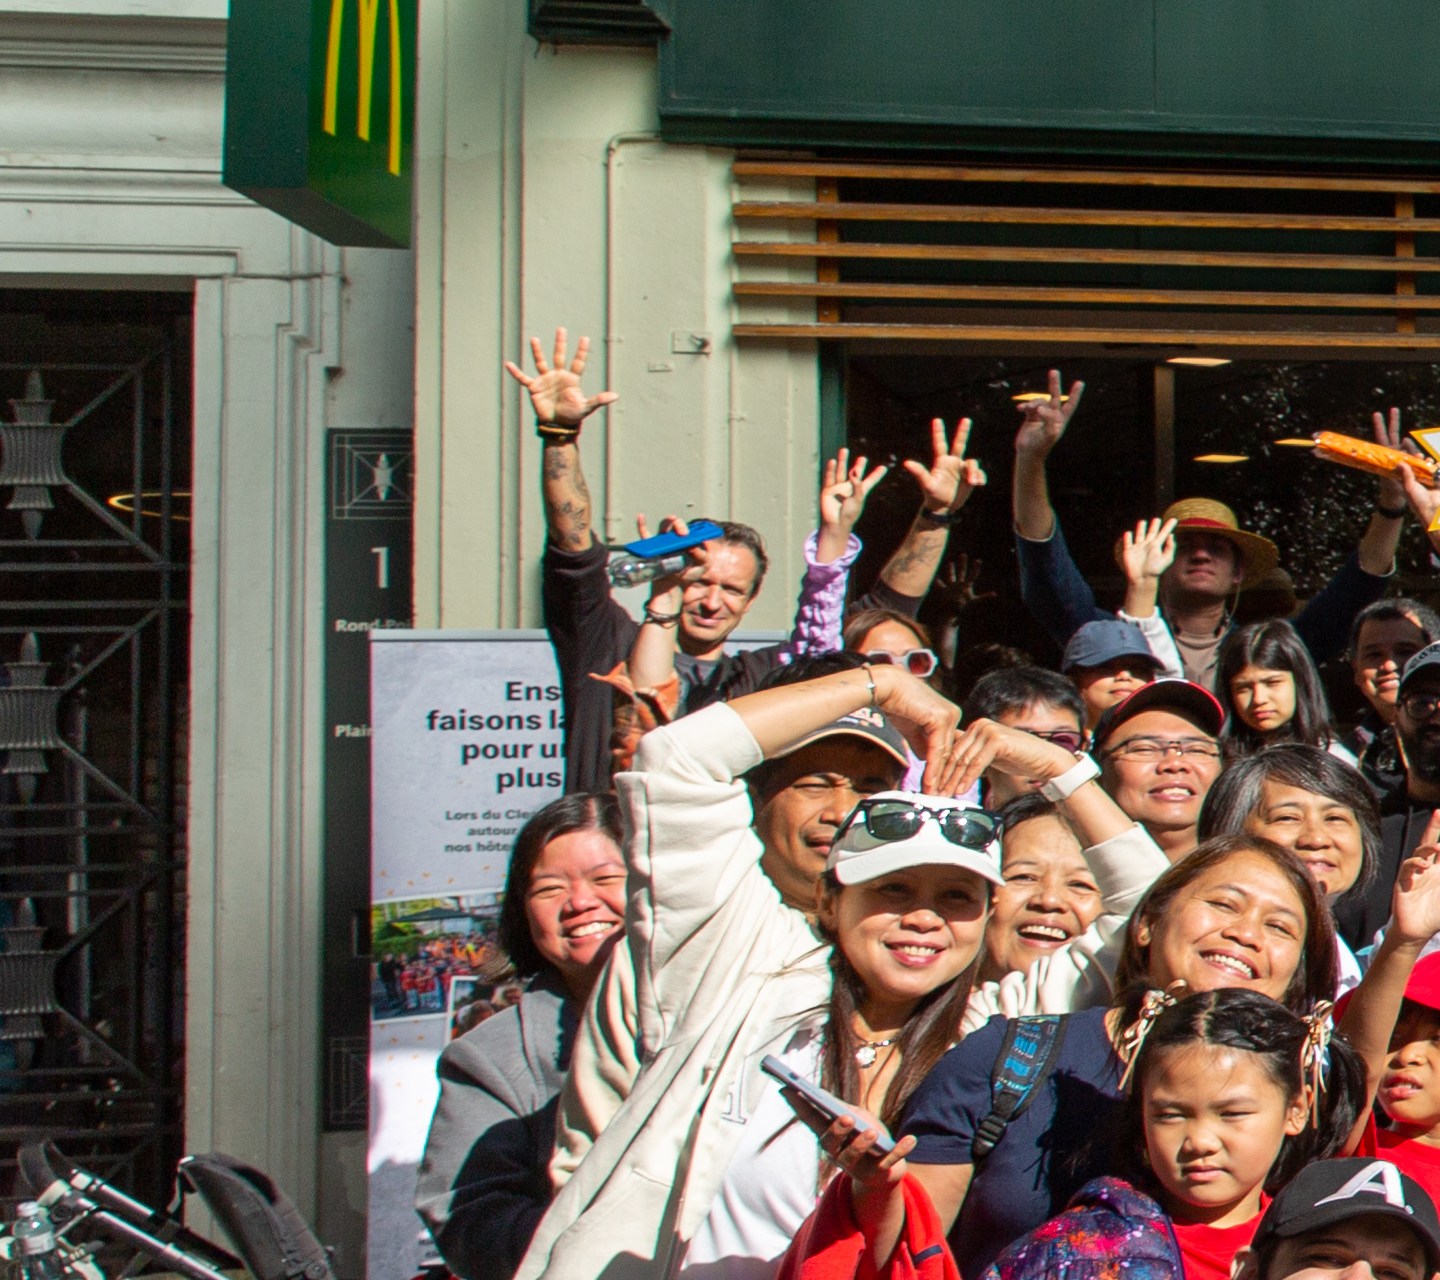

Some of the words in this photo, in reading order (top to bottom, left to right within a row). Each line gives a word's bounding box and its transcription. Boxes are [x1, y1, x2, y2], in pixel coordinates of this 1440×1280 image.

[370, 546, 390, 589] 1
[506, 681, 563, 702] Ens
[426, 709, 542, 731] faisons
[461, 743, 534, 765] pour
[496, 767, 562, 795] plus
